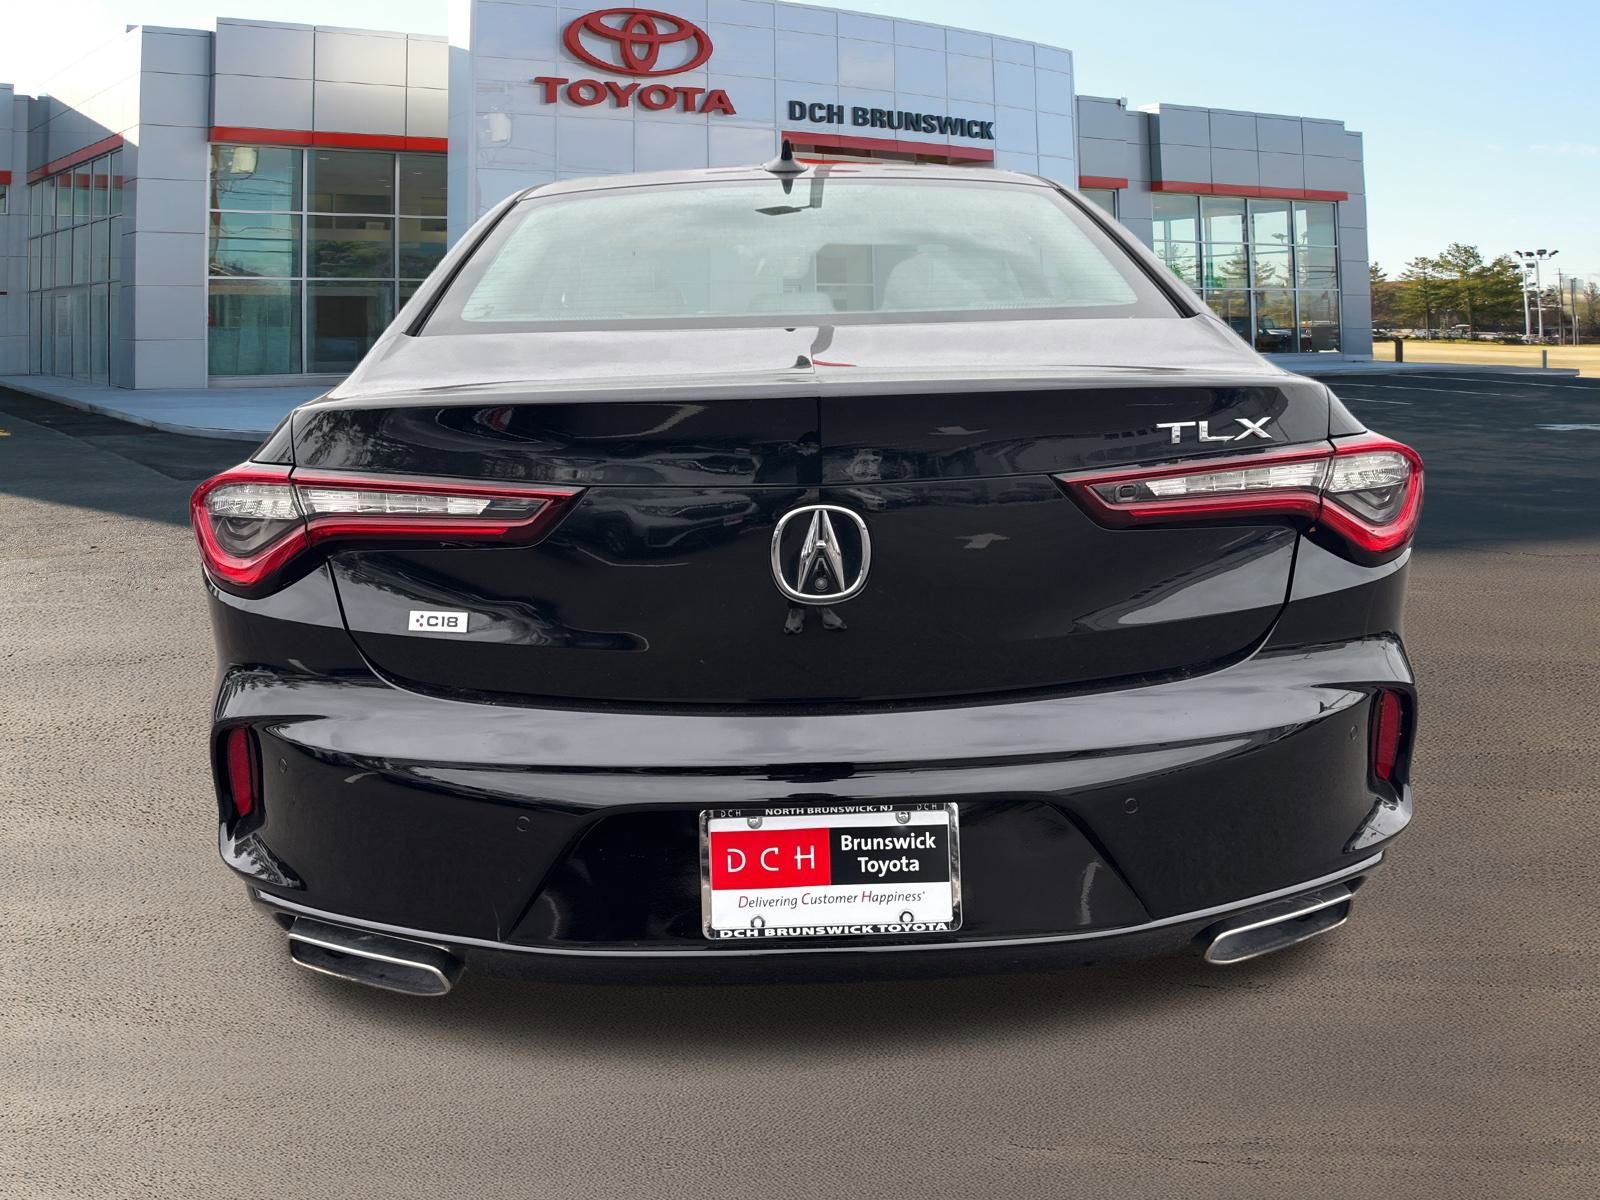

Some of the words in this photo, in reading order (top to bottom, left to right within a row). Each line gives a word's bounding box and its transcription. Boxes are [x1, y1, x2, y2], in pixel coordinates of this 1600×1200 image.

[534, 76, 737, 115] TOYOTA
[788, 100, 844, 124] DCH
[852, 106, 994, 140] BRUNSWICK
[1156, 416, 1273, 444] TLX
[765, 806, 804, 816] NORTH
[880, 804, 893, 812] NJ
[840, 832, 937, 851] Brunswick
[857, 856, 920, 877] Toyota
[738, 895, 798, 909] Delivering
[801, 892, 858, 906] Customer
[720, 928, 759, 938] DCH
[764, 925, 874, 937] BRUNSWICK
[877, 922, 948, 933] TOYOTA
